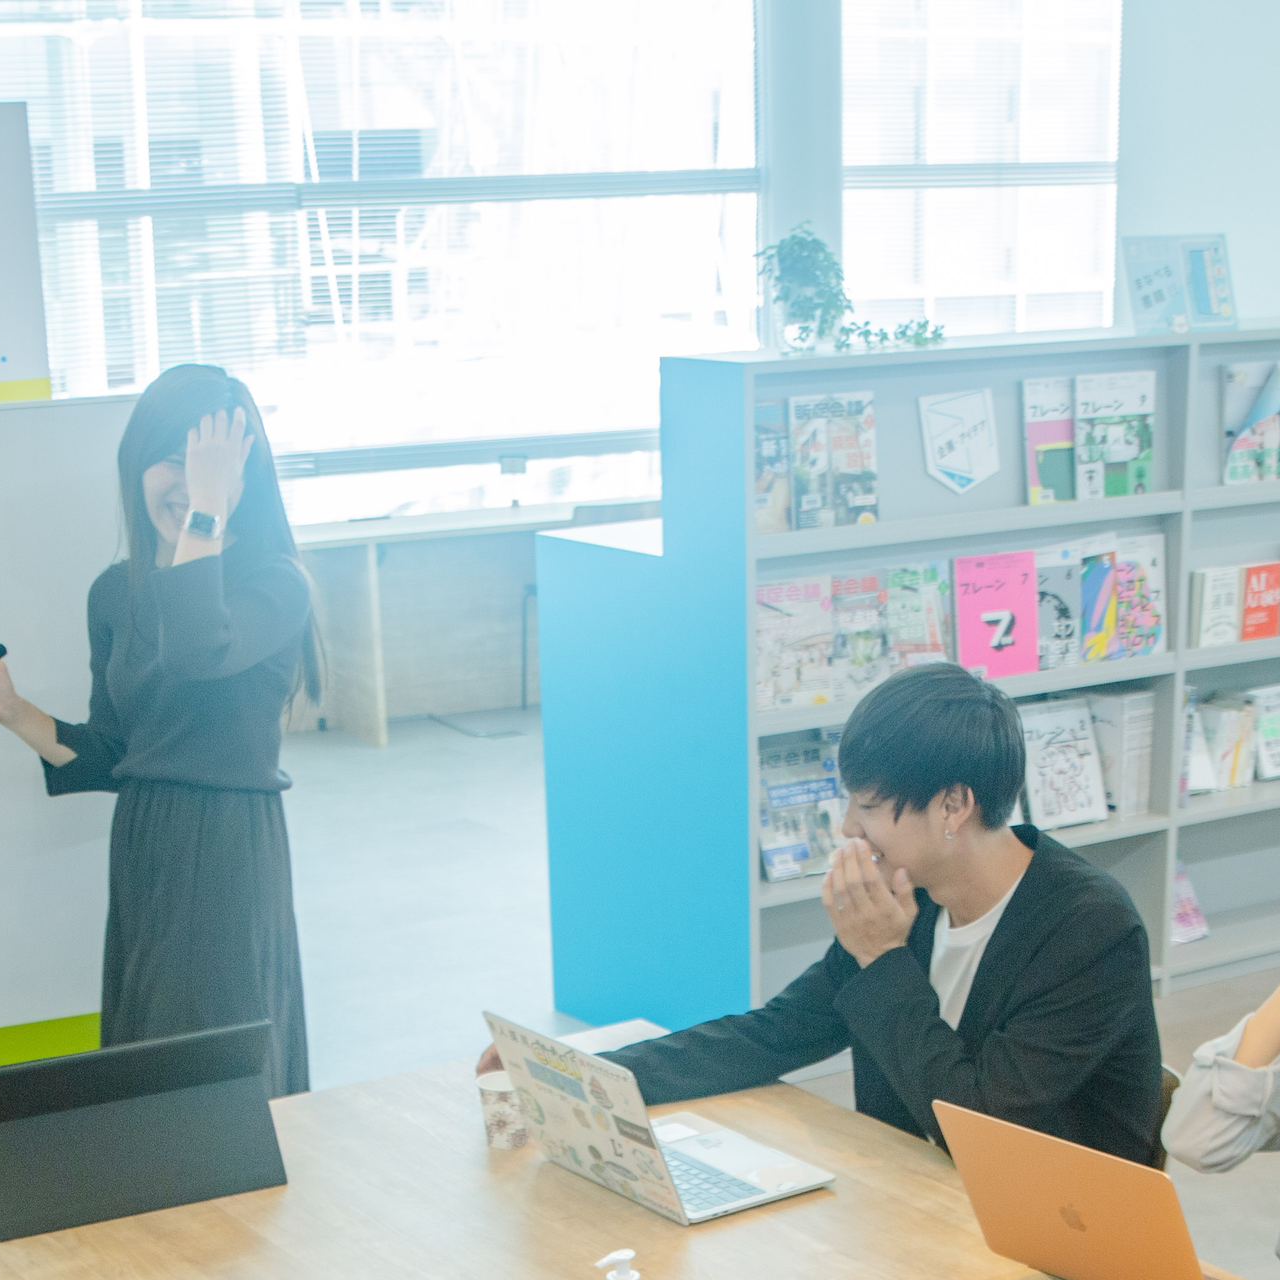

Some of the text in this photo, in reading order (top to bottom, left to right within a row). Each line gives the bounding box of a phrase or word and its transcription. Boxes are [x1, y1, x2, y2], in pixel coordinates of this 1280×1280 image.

[795, 400, 864, 420] 販促会議
[1029, 402, 1071, 418] ブレーン
[1081, 400, 1124, 415] ブレーン
[959, 579, 1006, 596] ブレーン
